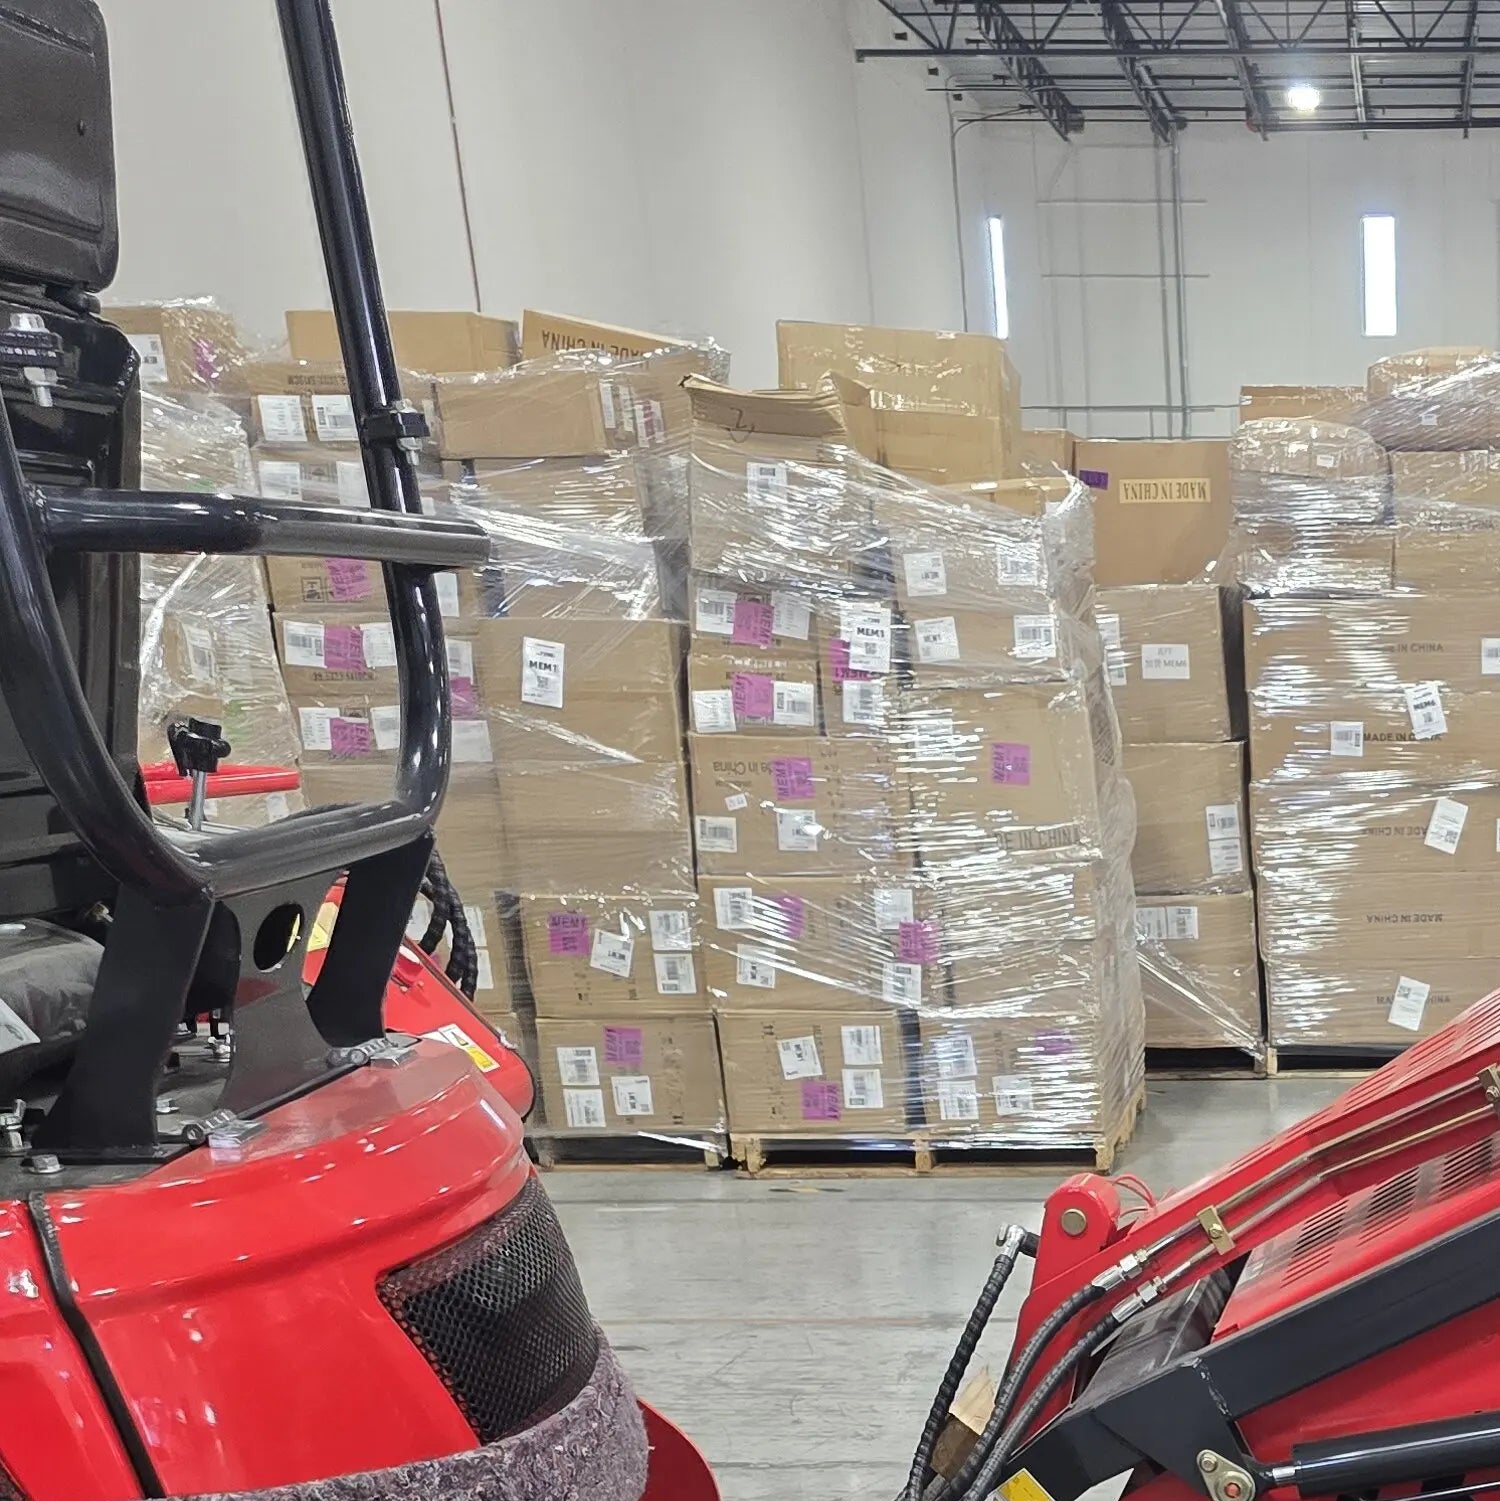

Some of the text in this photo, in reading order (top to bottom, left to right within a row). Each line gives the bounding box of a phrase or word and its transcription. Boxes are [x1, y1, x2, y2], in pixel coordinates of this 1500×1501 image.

[1123, 481, 1207, 500] MADE IN CHINA
[857, 626, 885, 638] MEM1
[1410, 643, 1444, 652] CHINA
[529, 659, 558, 672] MEM1
[1364, 733, 1393, 741] MADE
[713, 762, 746, 775] China
[1366, 914, 1398, 924] CHINA
[1414, 913, 1443, 923] MADE
